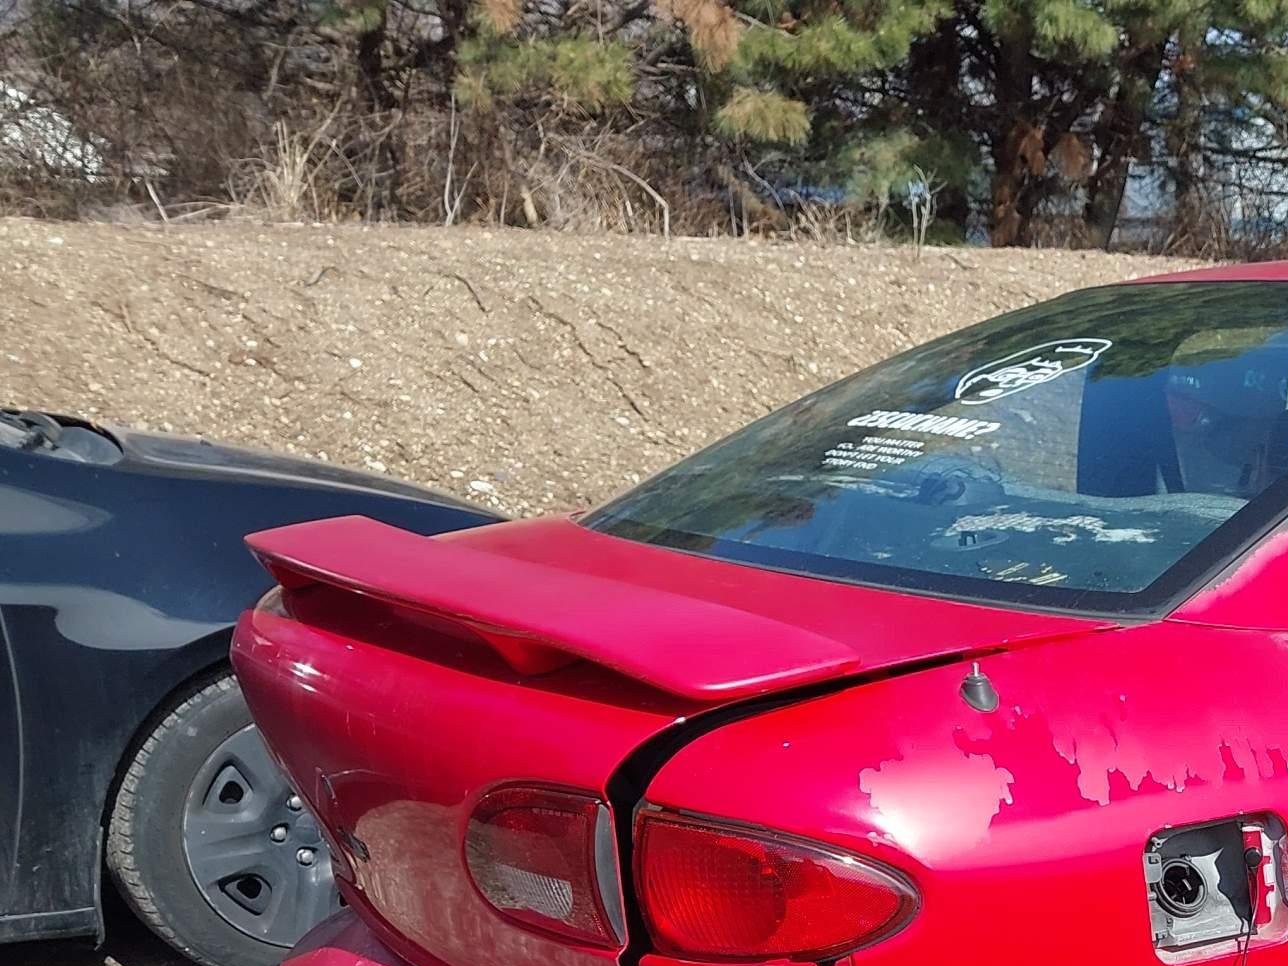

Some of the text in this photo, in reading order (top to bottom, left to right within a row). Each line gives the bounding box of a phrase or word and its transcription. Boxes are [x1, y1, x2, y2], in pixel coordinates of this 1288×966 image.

[862, 436, 925, 449] YOU MATTER
[856, 444, 880, 452] ARE
[877, 446, 924, 457] WORTHY
[856, 452, 878, 460] LET
[821, 457, 878, 470] STORY END
